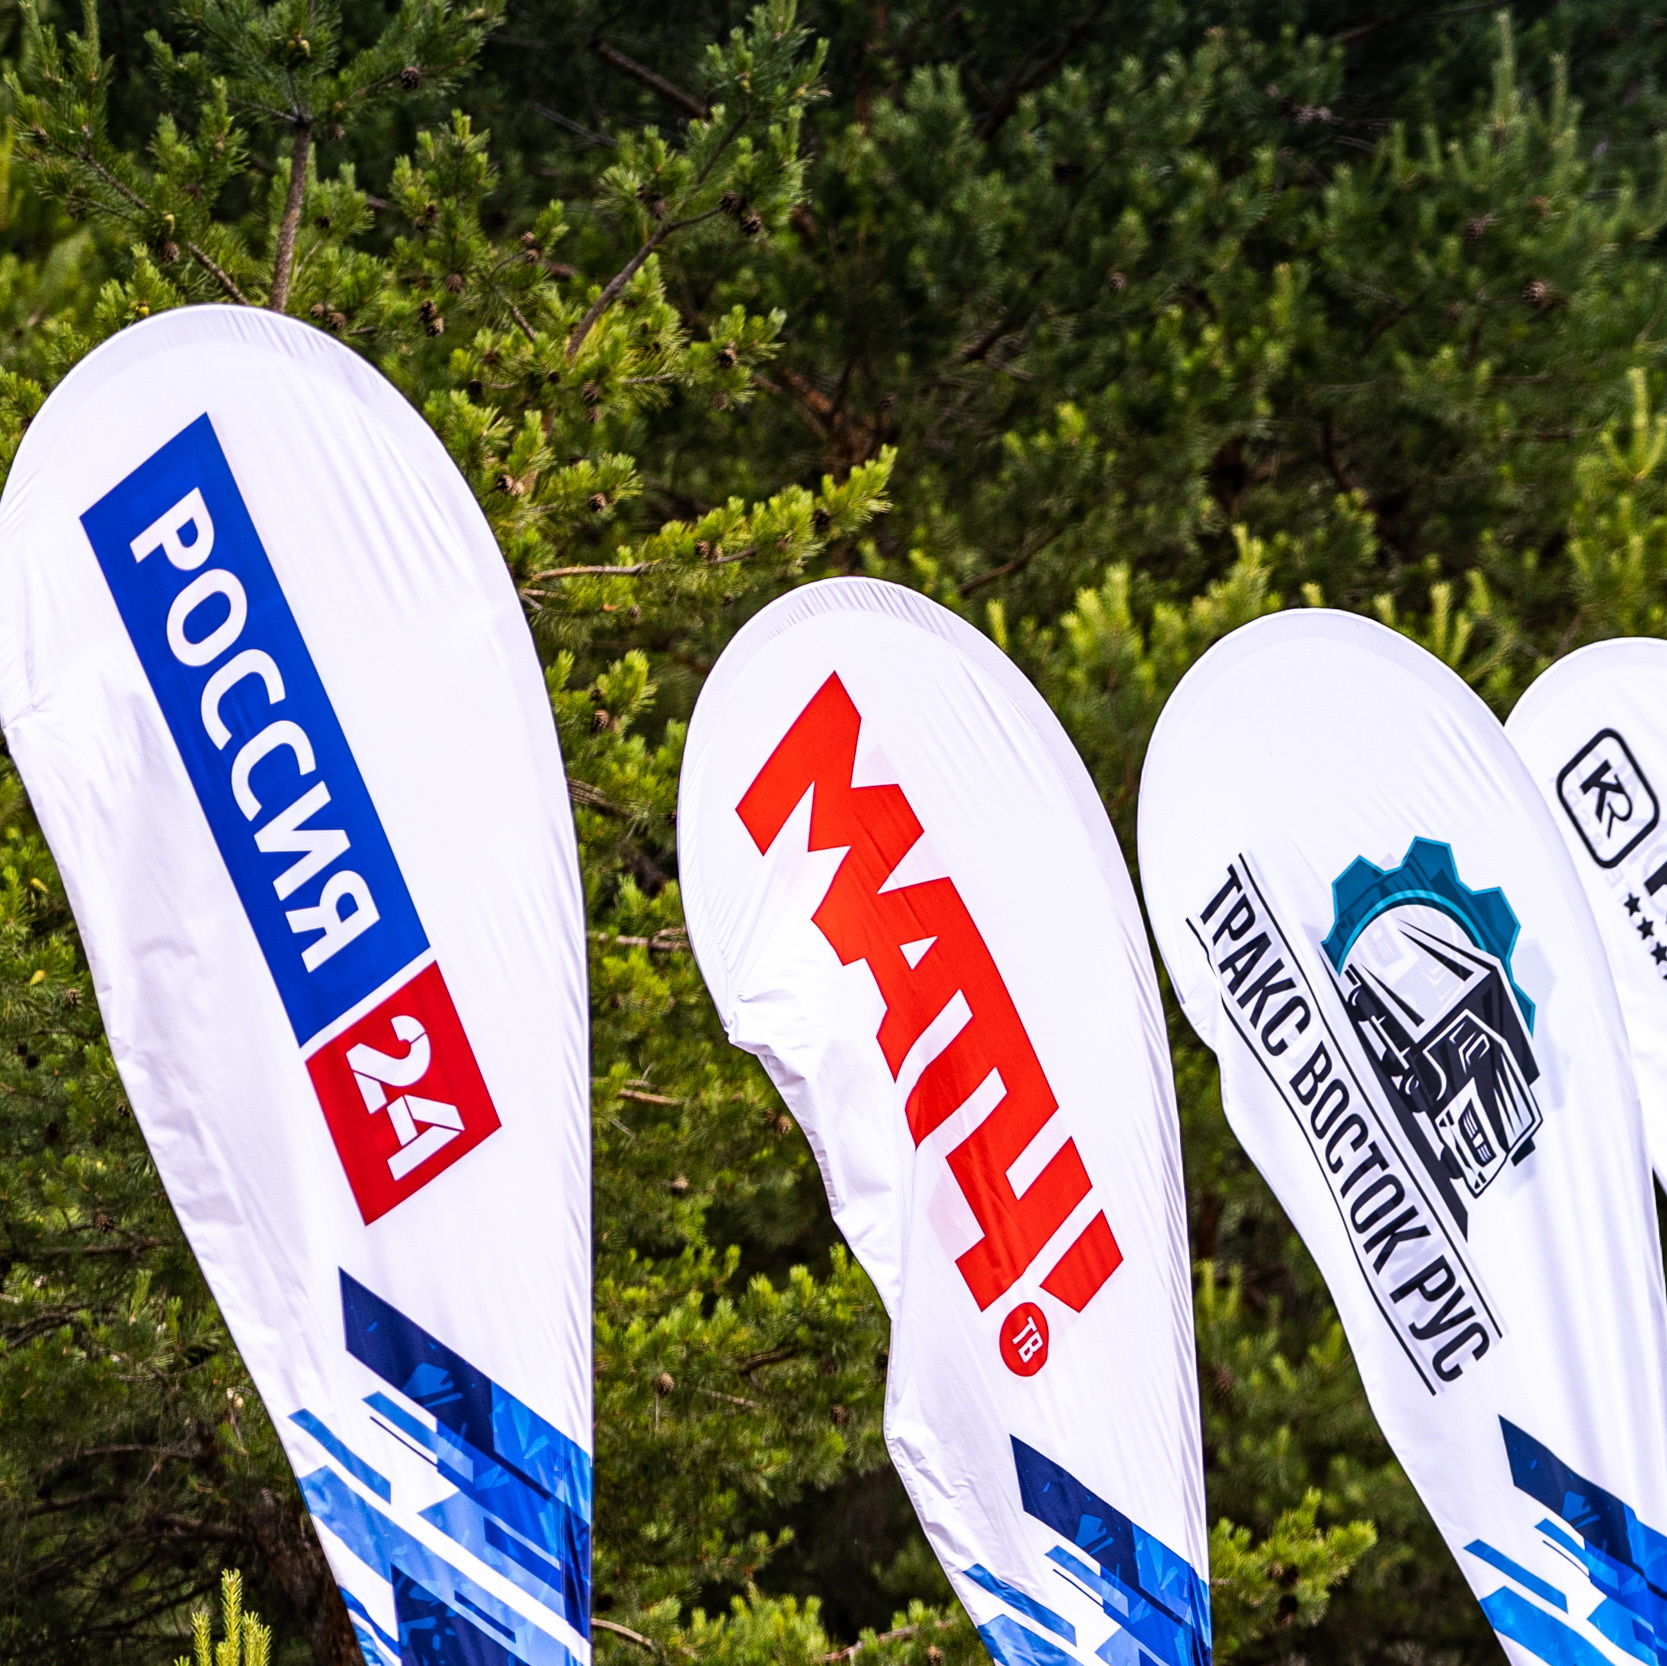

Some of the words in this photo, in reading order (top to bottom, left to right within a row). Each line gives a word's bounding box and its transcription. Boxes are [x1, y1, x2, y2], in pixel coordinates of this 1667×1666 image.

[129, 486, 380, 973] РОССИЯ
[346, 1014, 466, 1182] 24
[735, 670, 1123, 1314] МАТЧ!
[1199, 863, 1312, 1058] ТРАКС
[1289, 1039, 1432, 1276] ВОСТОК
[1389, 1254, 1491, 1384] РУС
[1012, 1315, 1044, 1363] ТВ
